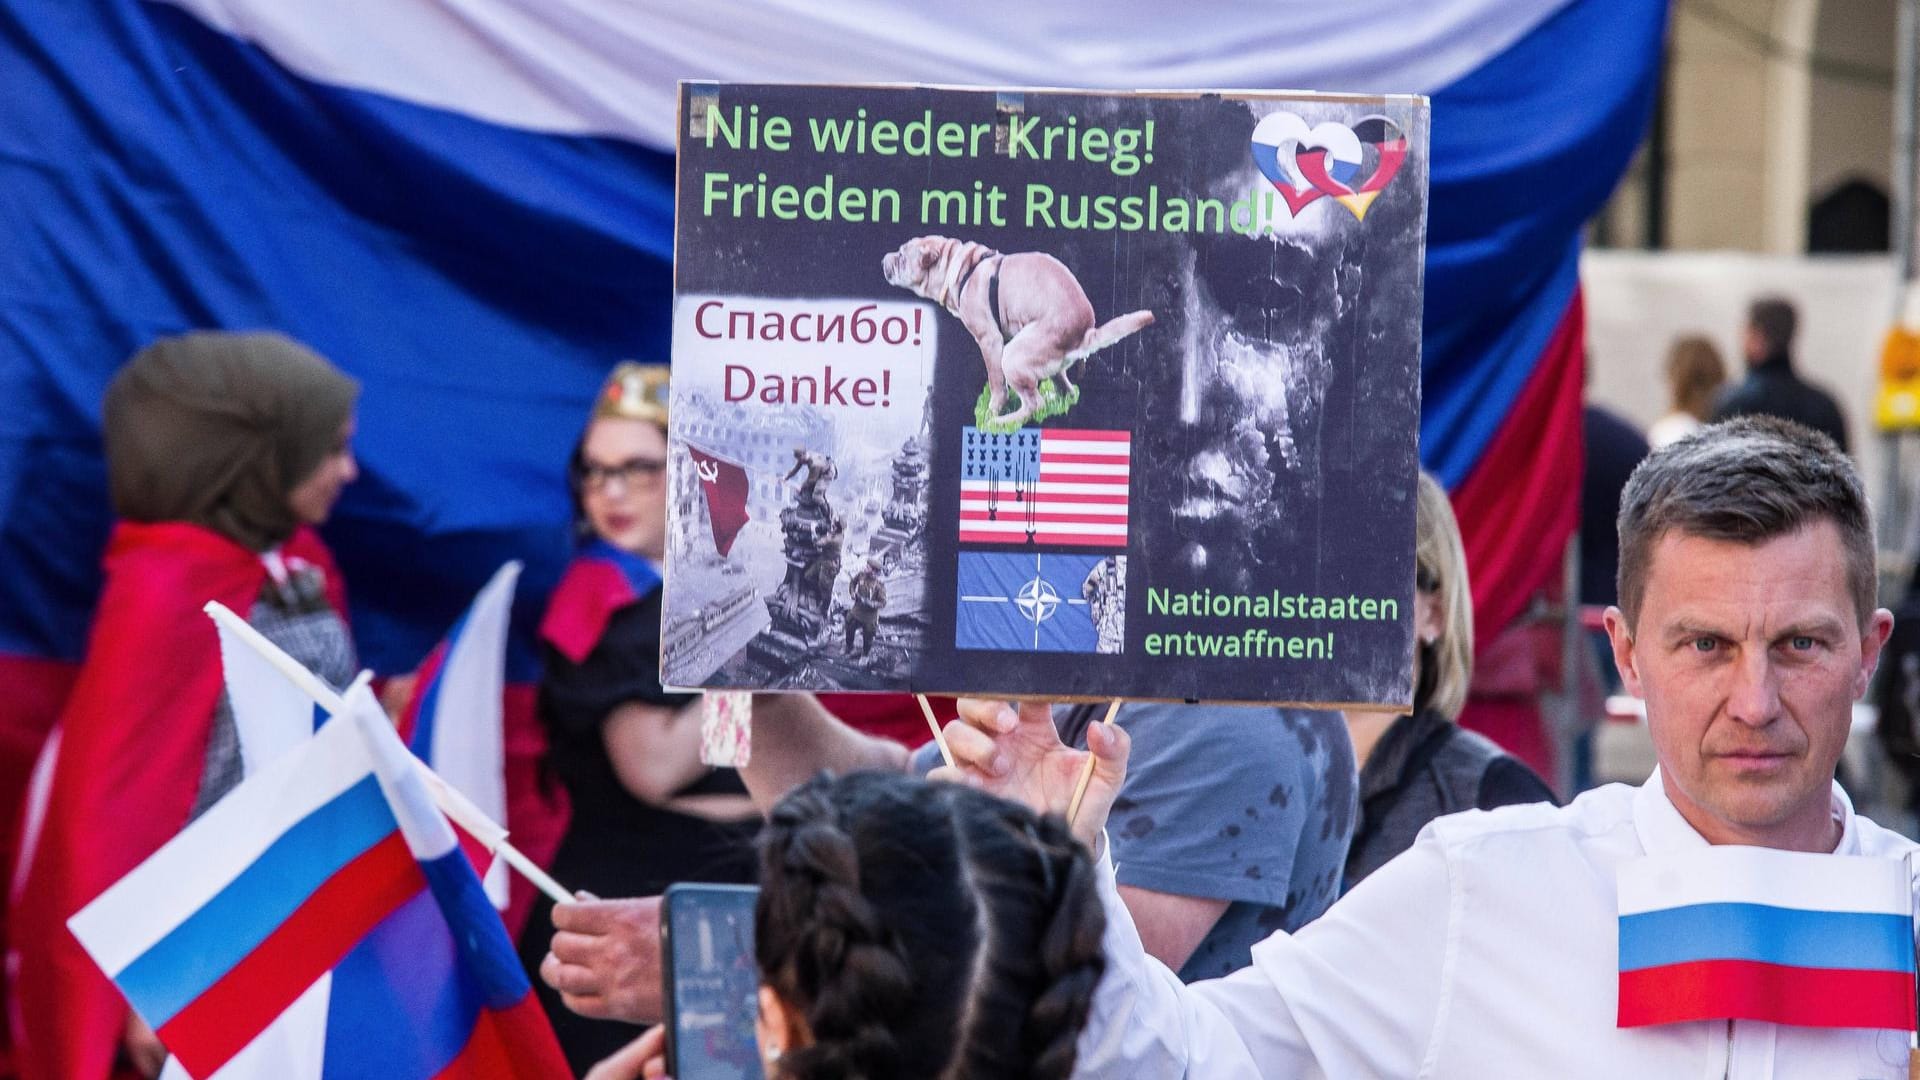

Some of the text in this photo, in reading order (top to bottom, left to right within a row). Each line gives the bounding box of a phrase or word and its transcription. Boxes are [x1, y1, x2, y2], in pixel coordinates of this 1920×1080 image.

[706, 105, 1154, 176] Nie wieder Krieg!
[703, 172, 1274, 234] Frieden mit Russland!
[695, 301, 922, 345] Спасибо!
[724, 364, 890, 407] Danke!
[1147, 588, 1397, 620] Nationalstaaten
[1145, 628, 1333, 659] entwaffnen!
